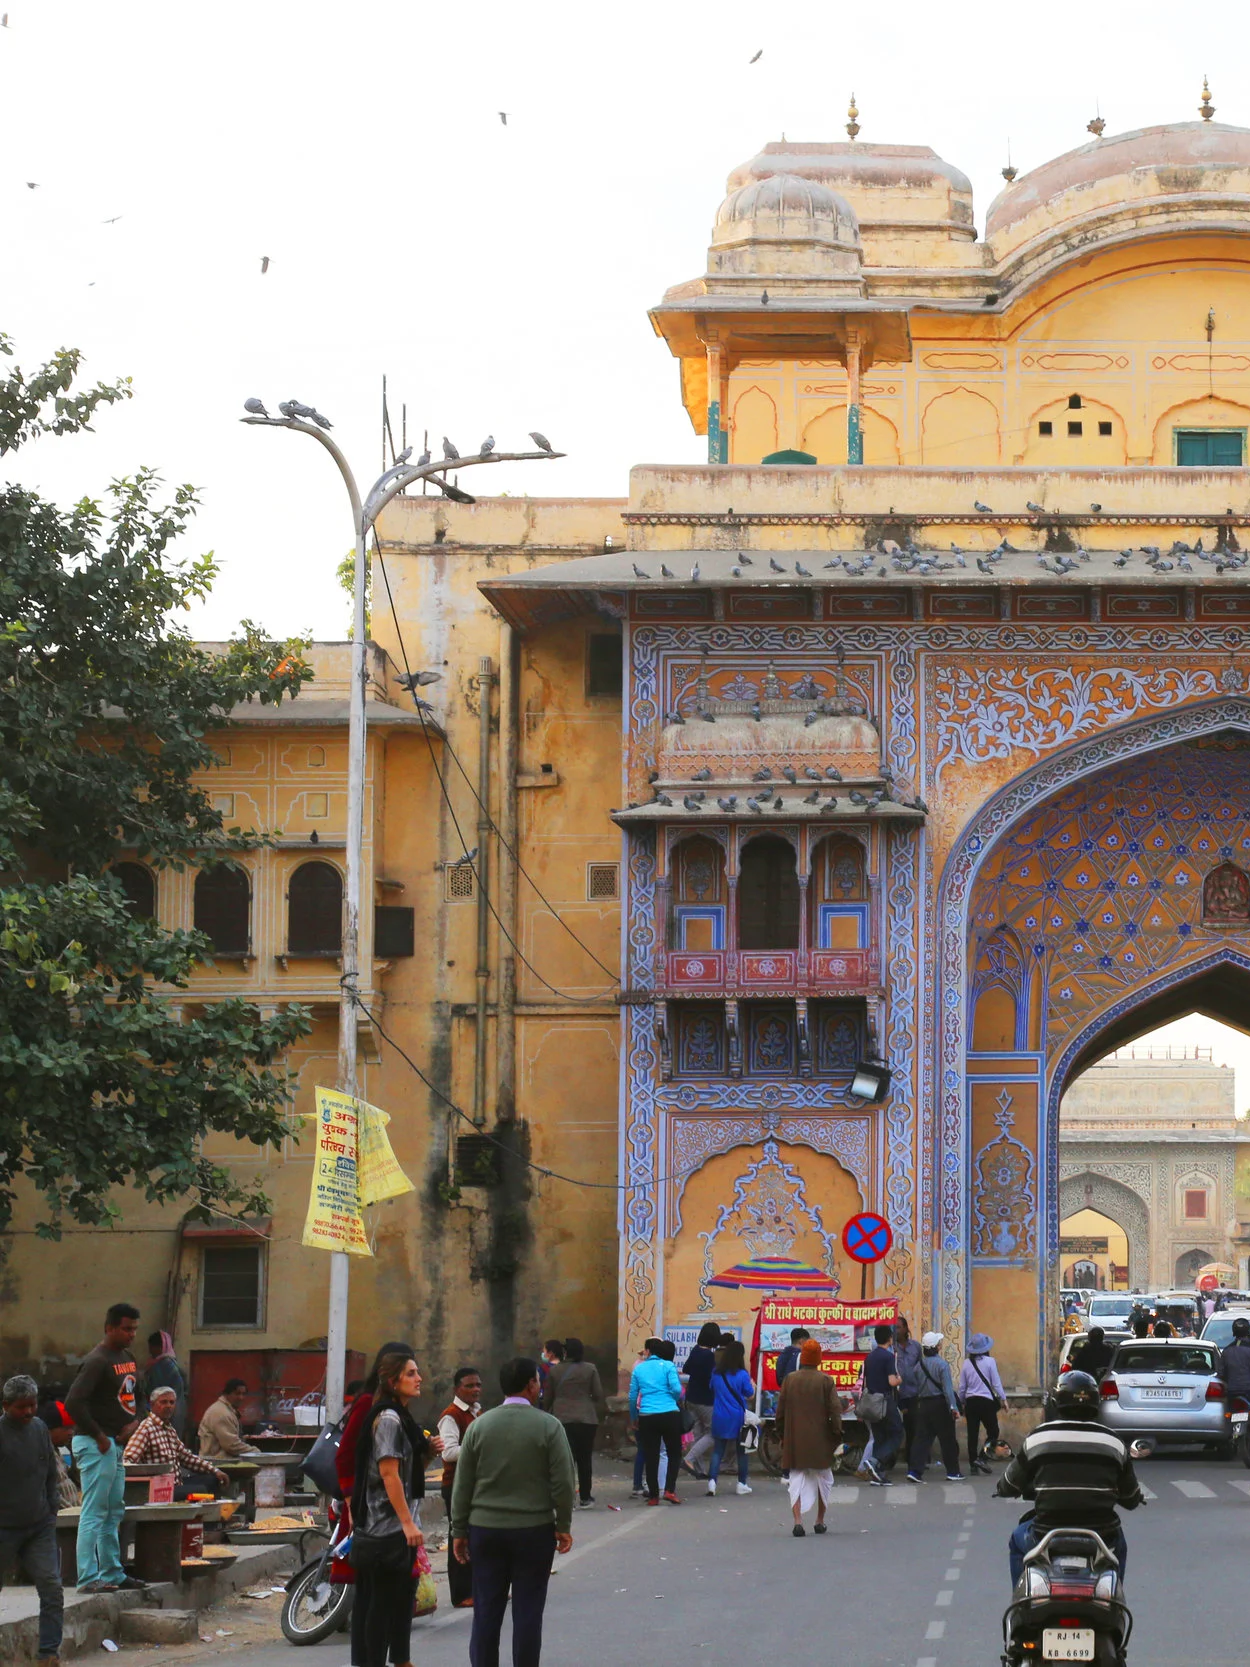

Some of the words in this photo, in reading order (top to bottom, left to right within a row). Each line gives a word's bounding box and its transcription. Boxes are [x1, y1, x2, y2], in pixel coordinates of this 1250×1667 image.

[765, 1303, 776, 1320] श्री
[777, 1302, 792, 1319] राधे
[793, 1306, 817, 1320] मटका
[818, 1303, 844, 1324] कुल्फी
[852, 1306, 876, 1320] बादाम
[666, 1331, 697, 1343] SULABH
[1057, 1632, 1067, 1640] RJ
[1072, 1632, 1081, 1640] 14
[1066, 1648, 1089, 1657] 6699
